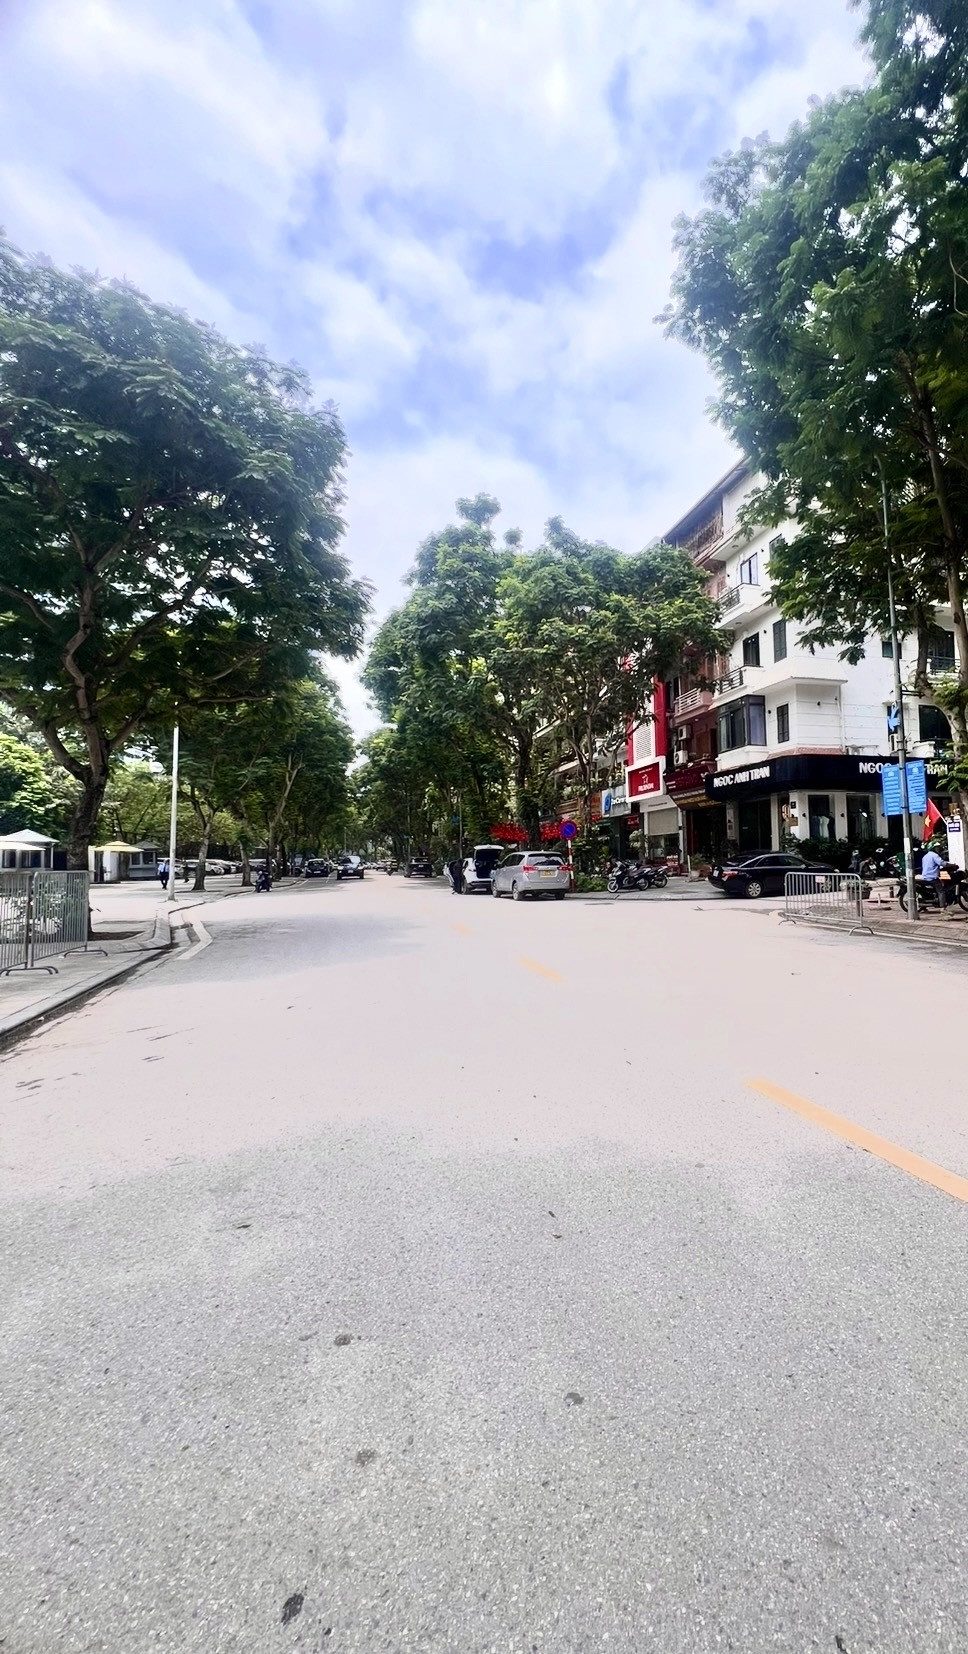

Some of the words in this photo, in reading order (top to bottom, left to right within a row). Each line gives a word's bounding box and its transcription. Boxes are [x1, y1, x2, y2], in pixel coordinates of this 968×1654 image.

[858, 762, 891, 774] NGO
[713, 774, 734, 788] NGOC
[733, 770, 750, 784] ANH
